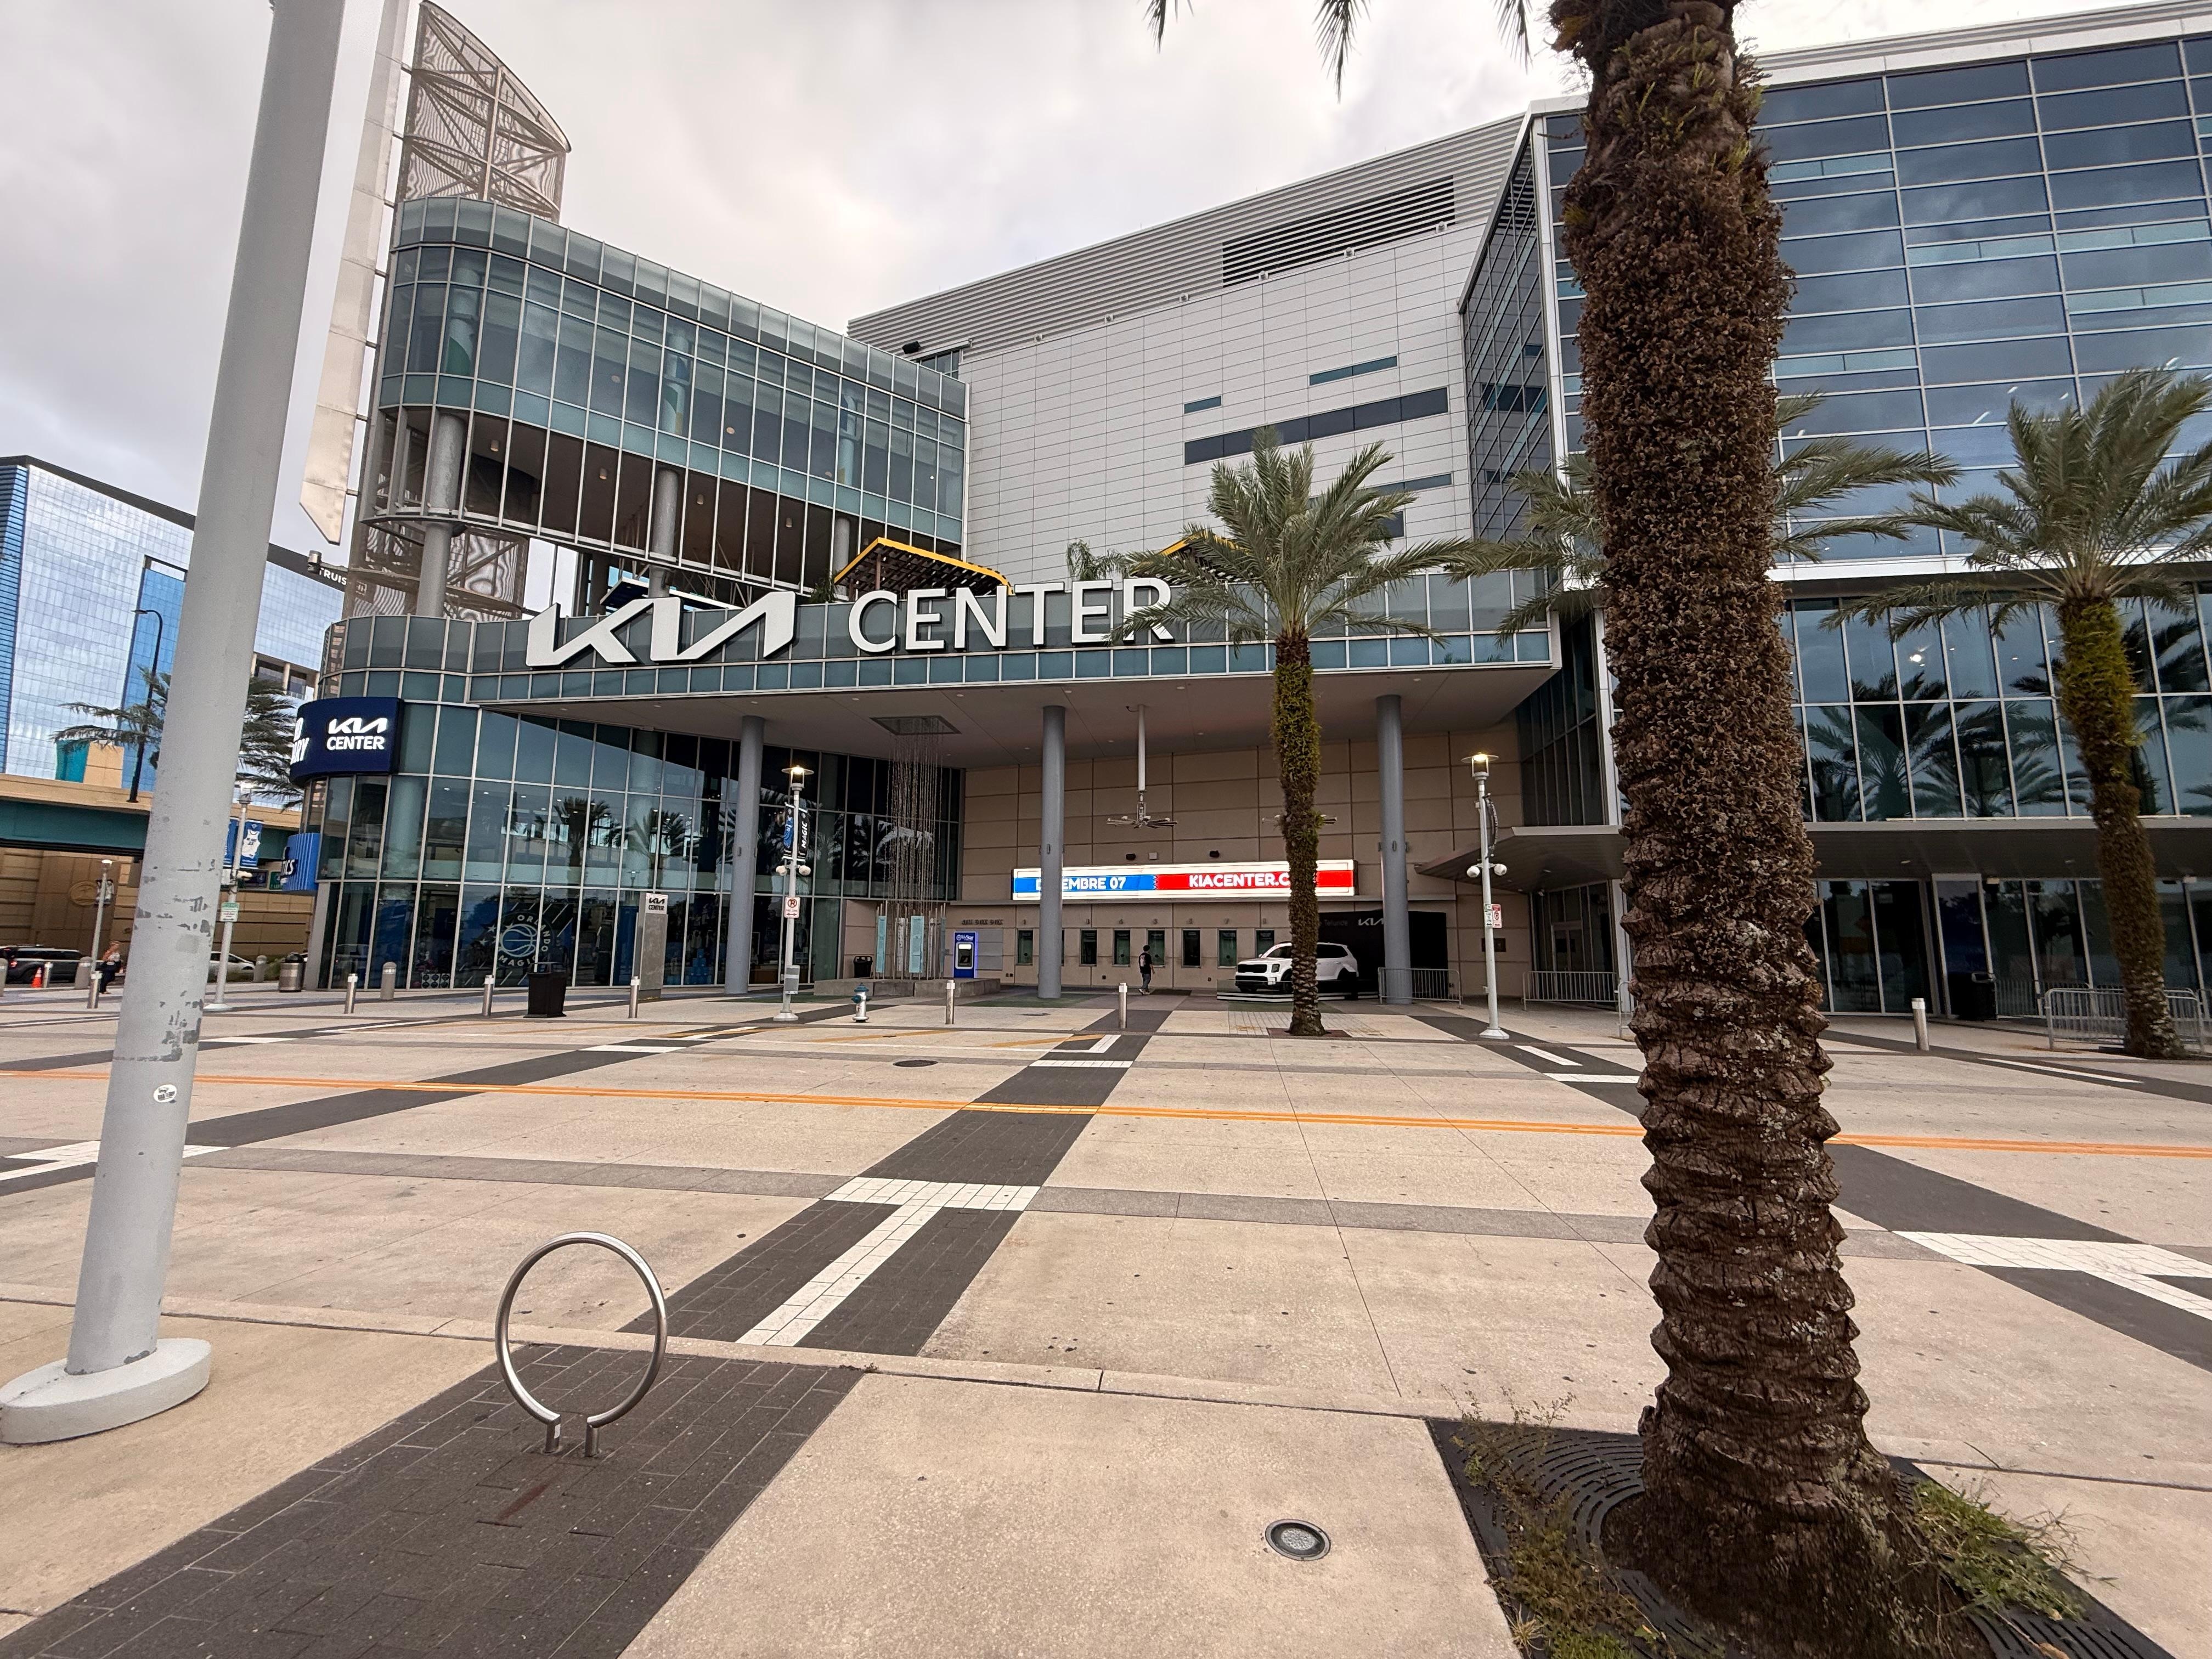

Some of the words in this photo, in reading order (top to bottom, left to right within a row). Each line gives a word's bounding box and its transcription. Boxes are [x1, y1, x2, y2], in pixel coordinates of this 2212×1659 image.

[526, 591, 795, 667] KIA
[848, 578, 1175, 653] CENTER
[328, 718, 388, 734] KIA
[326, 736, 385, 751] CENTER
[1109, 877, 1126, 889] 07
[1189, 872, 1290, 888] KIACENTER.C
[517, 915, 551, 952] ORLANDO
